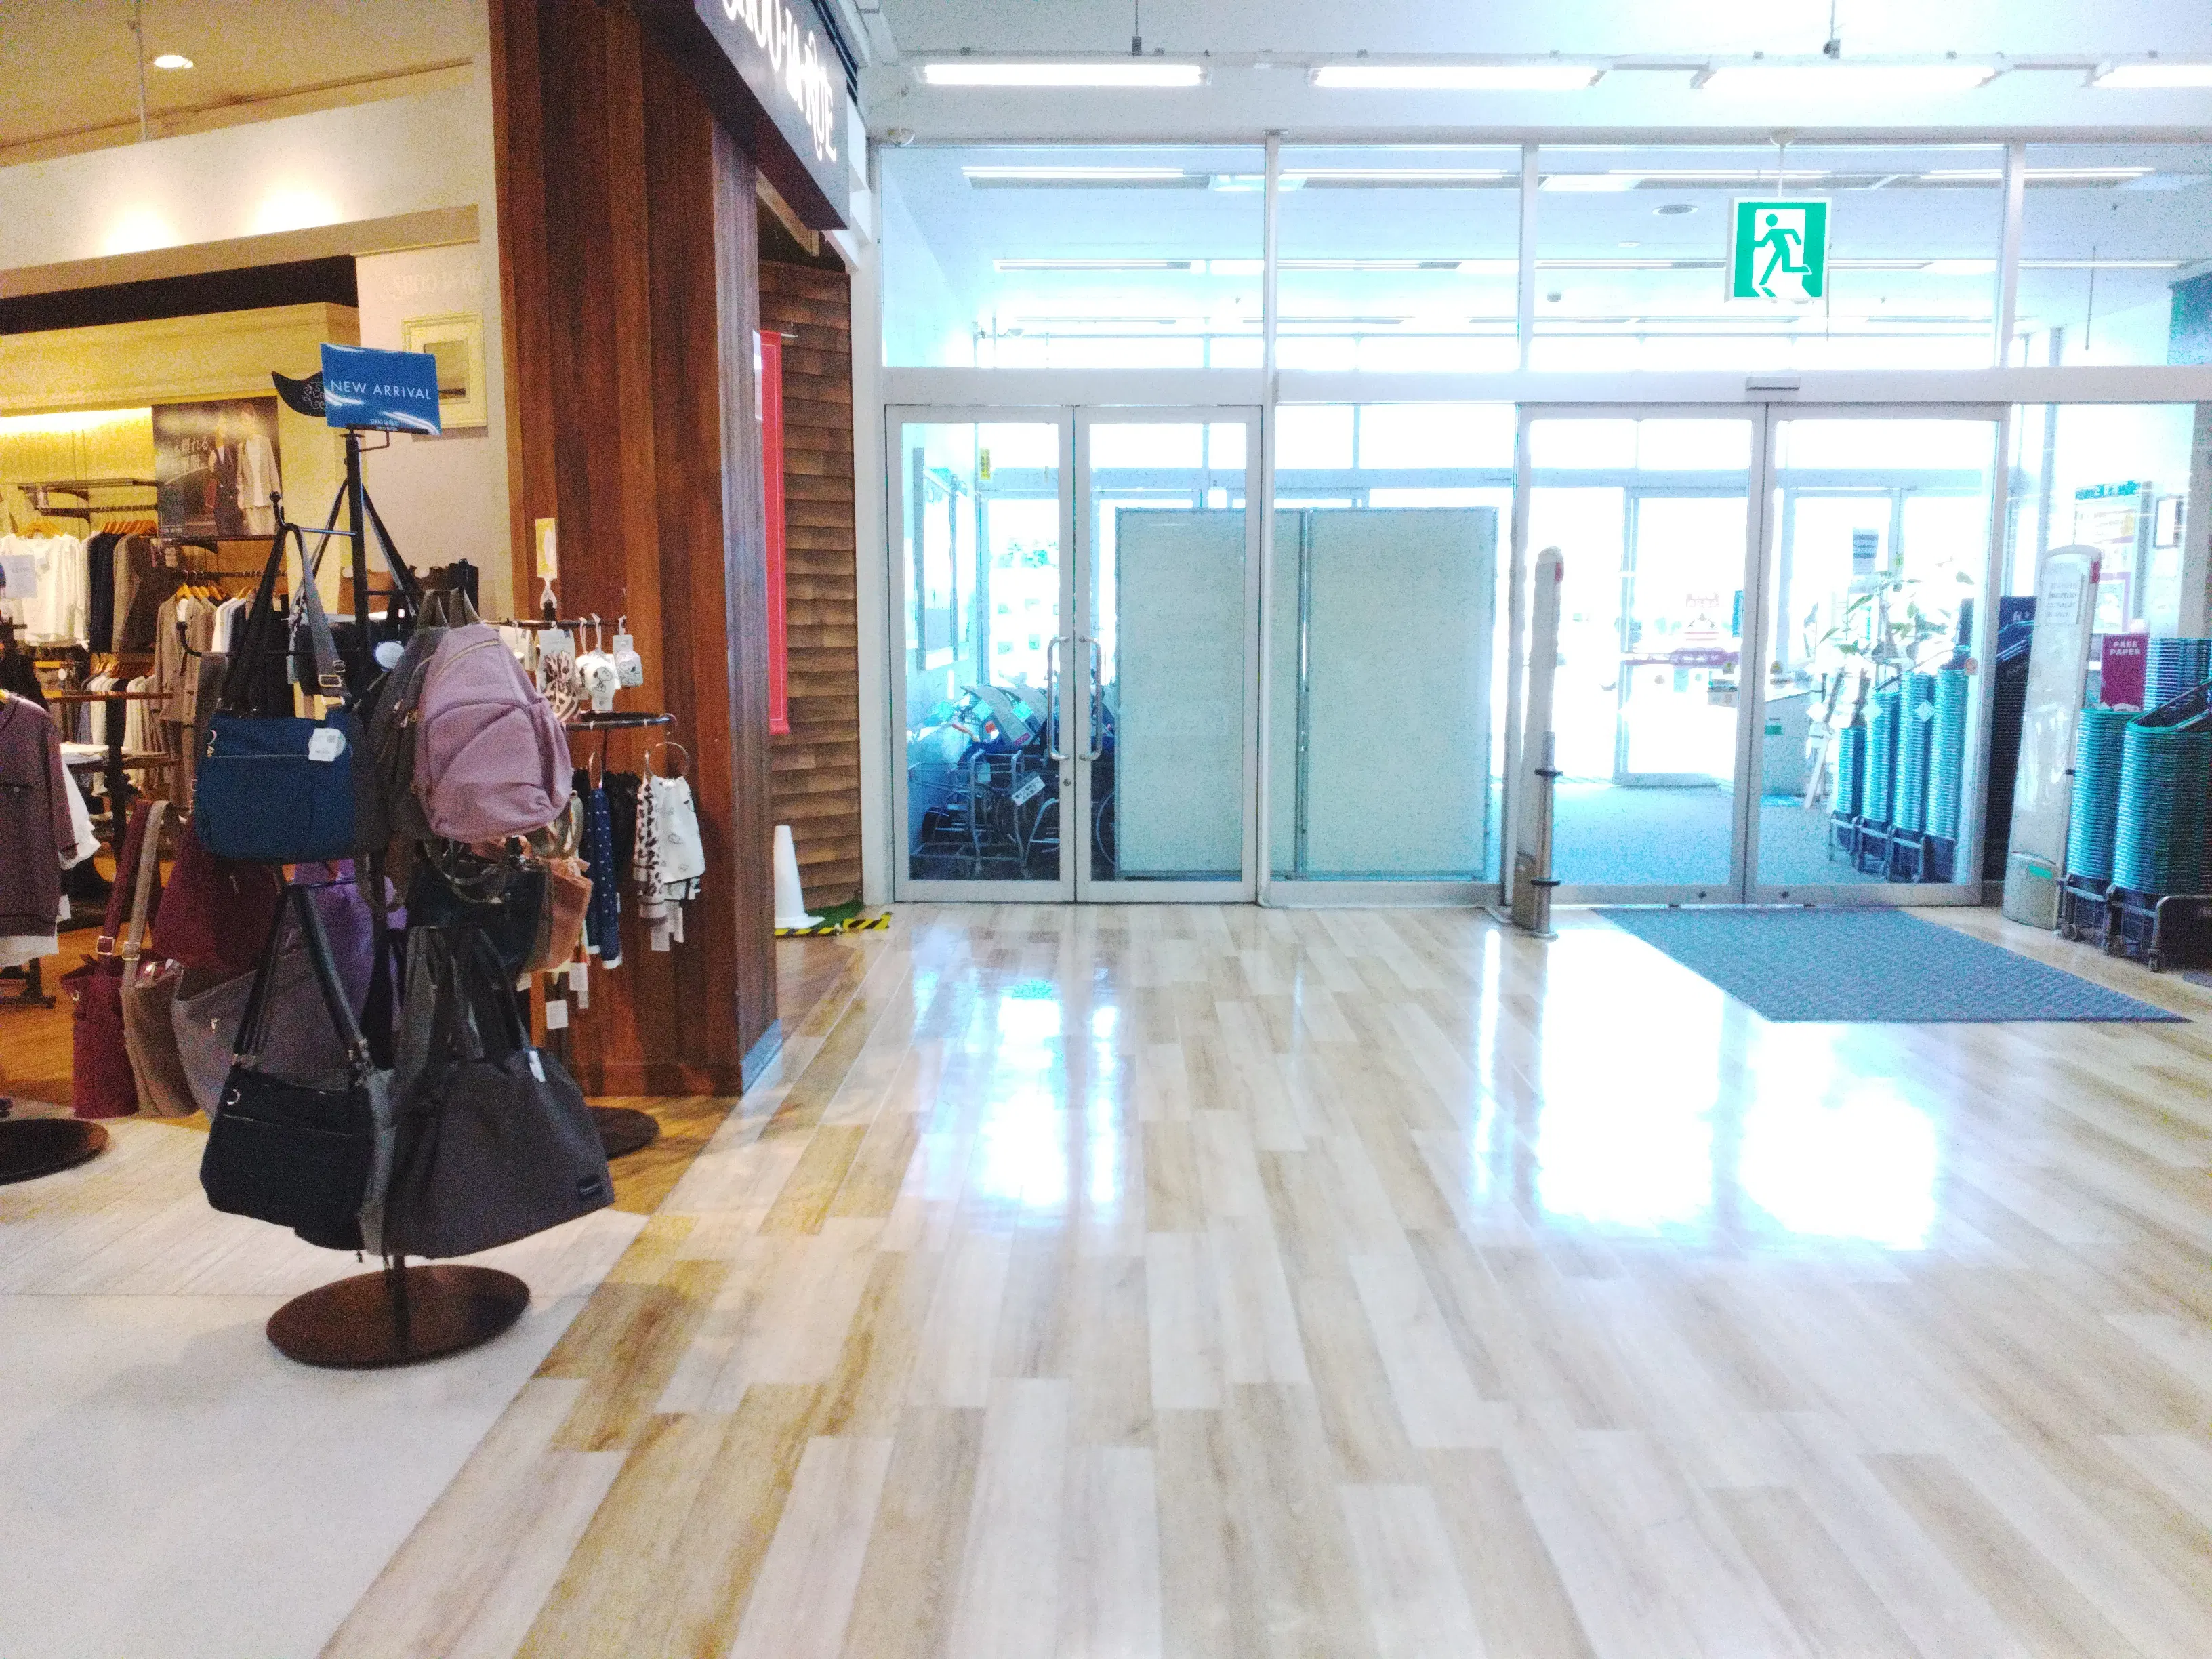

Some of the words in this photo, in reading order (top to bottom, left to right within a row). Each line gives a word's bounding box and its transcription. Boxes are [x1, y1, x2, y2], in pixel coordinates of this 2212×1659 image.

[330, 380, 367, 394] NEW
[373, 384, 432, 400] ARRIVAL
[2113, 640, 2138, 649] FREE
[2110, 647, 2141, 656] PAPER
